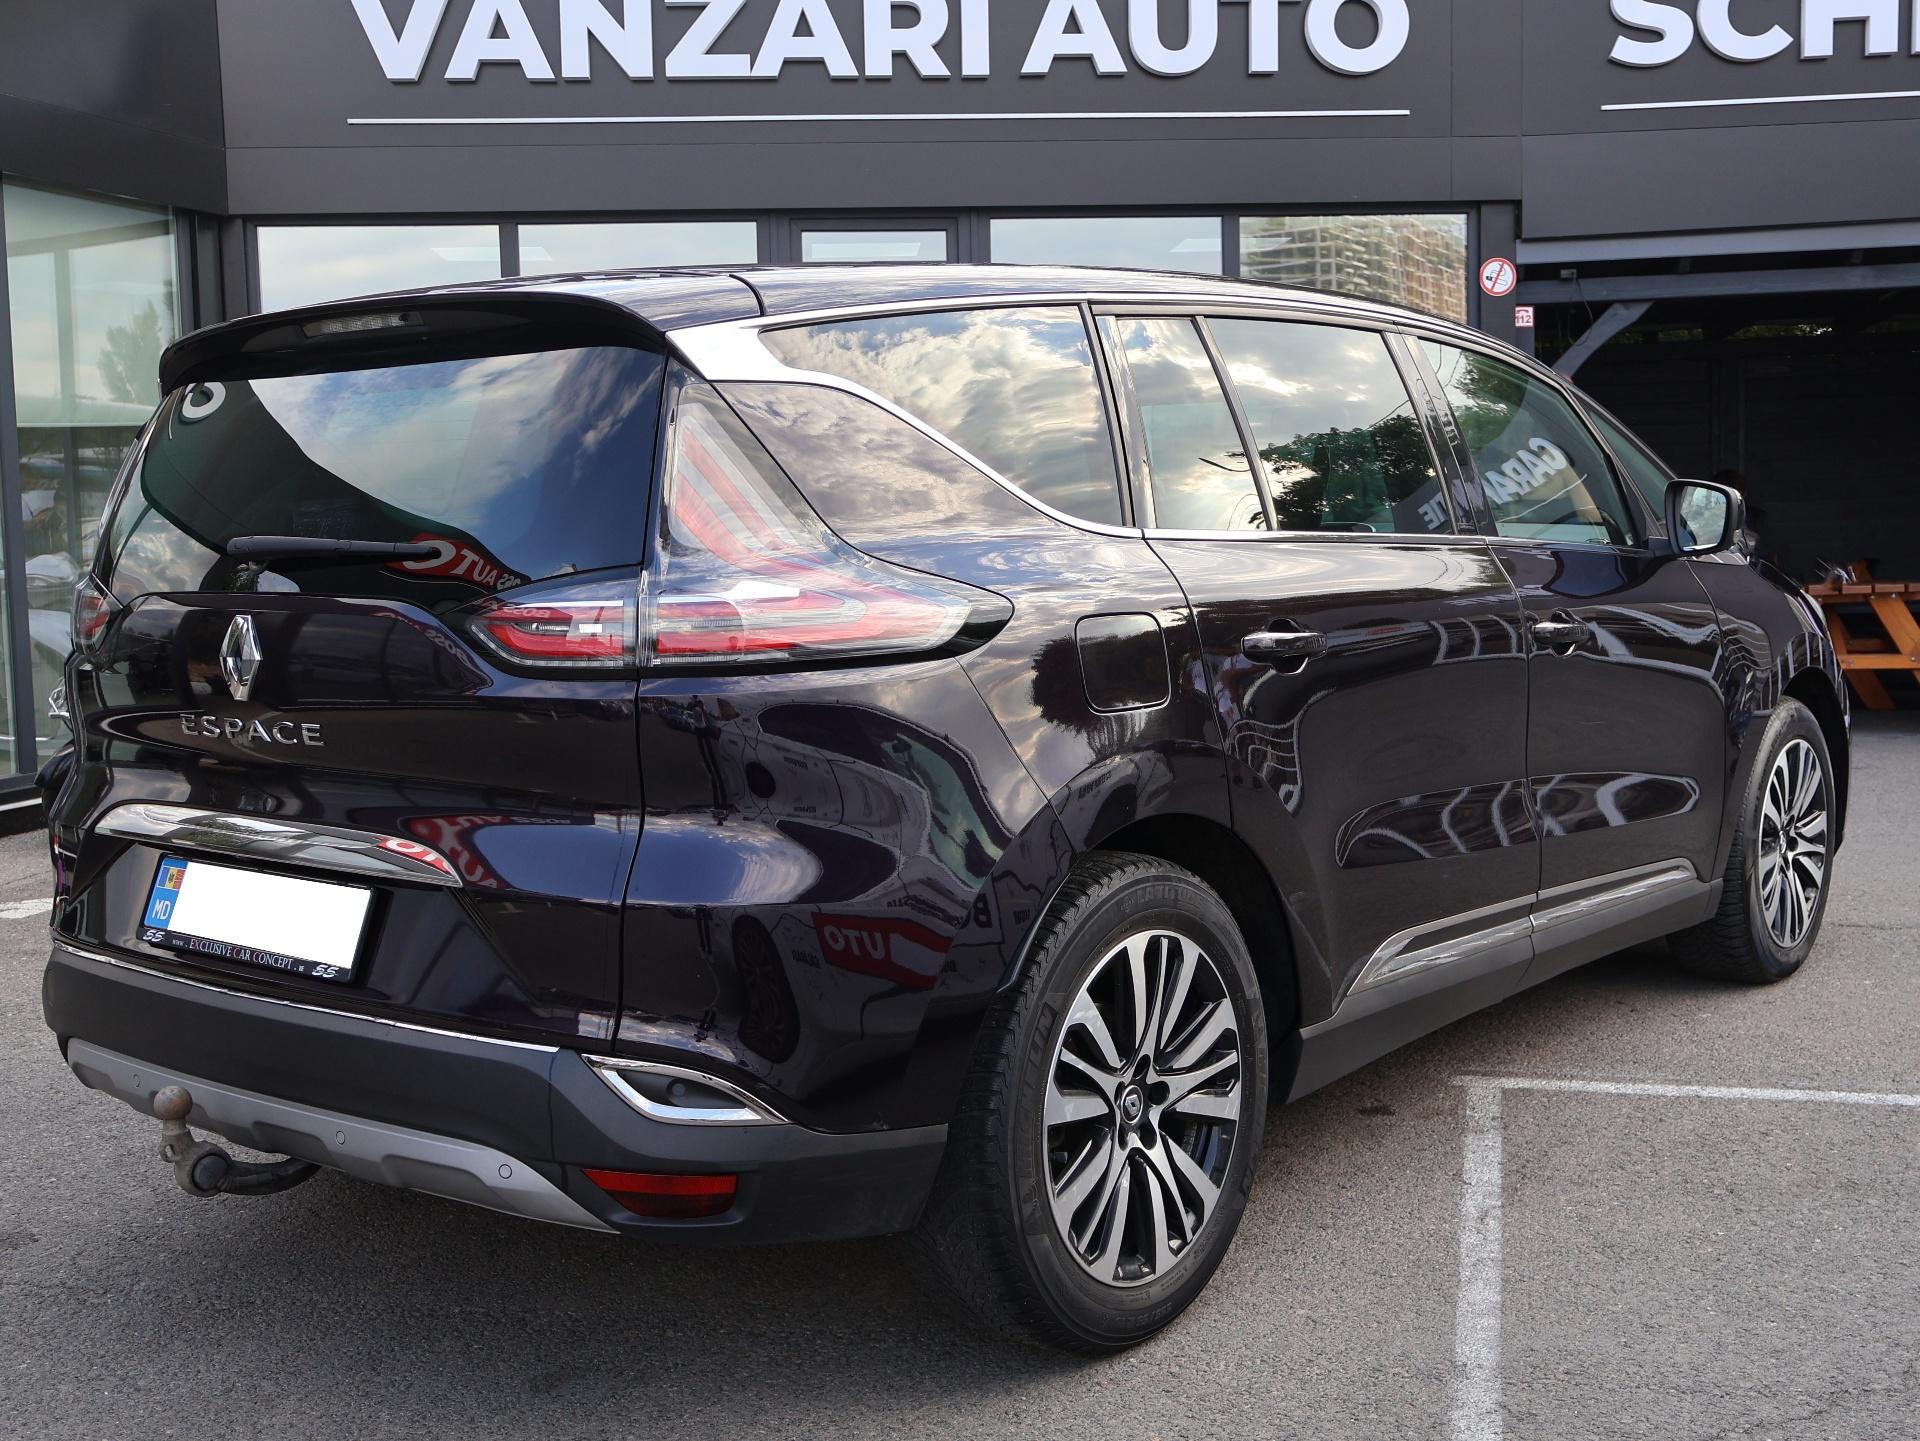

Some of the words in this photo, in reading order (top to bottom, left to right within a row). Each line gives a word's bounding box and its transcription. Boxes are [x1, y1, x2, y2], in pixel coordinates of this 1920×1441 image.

[1019, 0, 1410, 76] AUTO
[1515, 314, 1531, 324] 112
[179, 713, 325, 746] ESPACE
[152, 899, 171, 920] MD
[189, 938, 233, 957] EXCLUSIVE
[233, 947, 251, 961] CAR
[253, 951, 295, 970] CONCEPT
